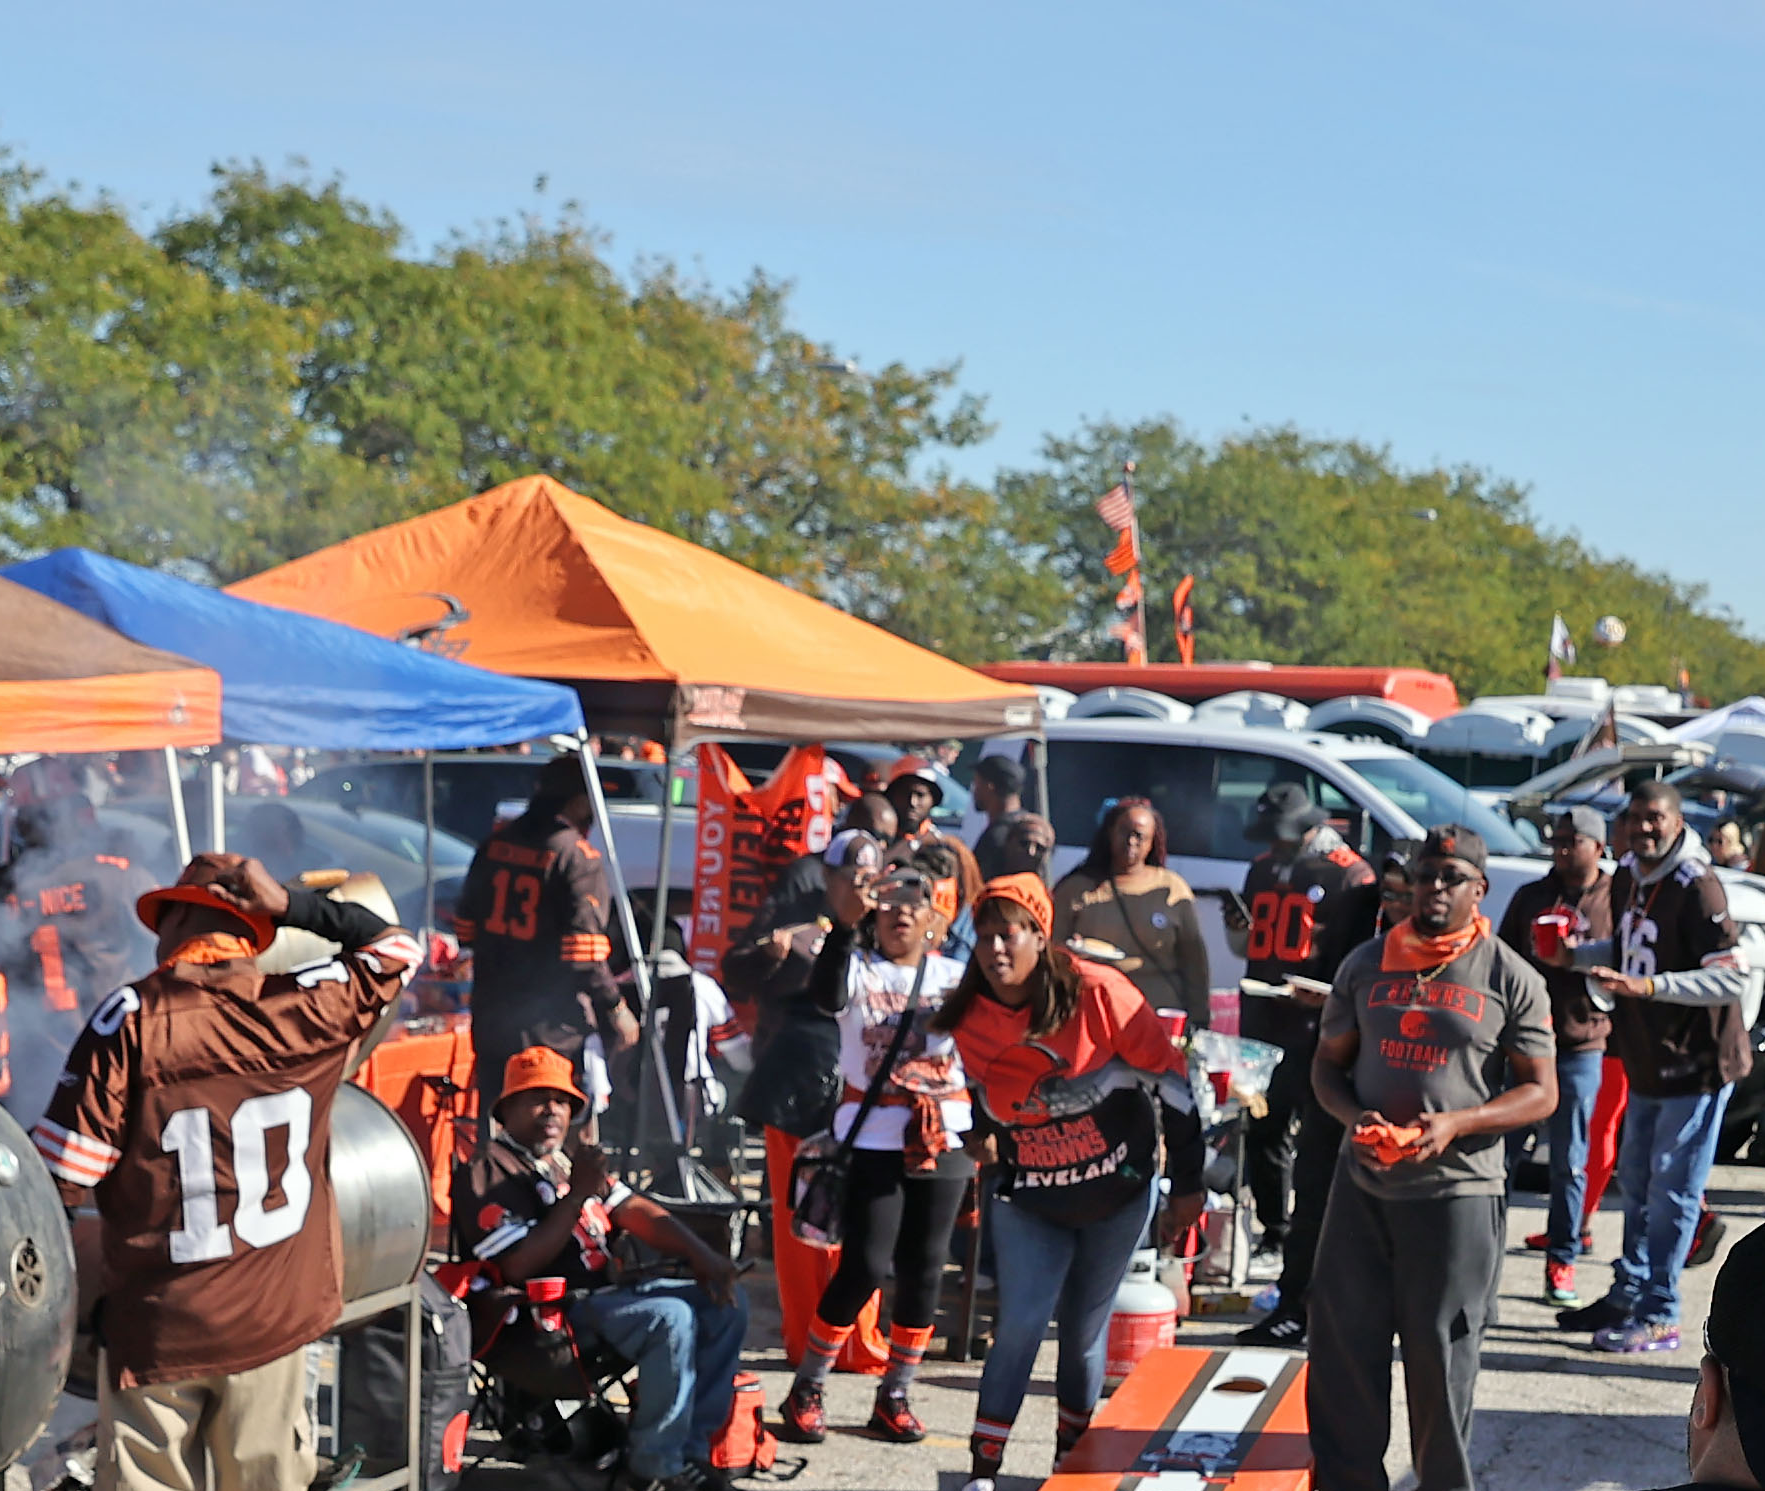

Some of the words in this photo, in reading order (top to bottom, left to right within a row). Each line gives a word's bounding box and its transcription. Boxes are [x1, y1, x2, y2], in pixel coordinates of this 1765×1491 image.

[486, 868, 541, 941] 13
[1247, 891, 1315, 962] 80
[1380, 1038, 1449, 1065] FOOTBALL
[161, 1086, 312, 1264] 10
[1013, 1141, 1128, 1190] LEVELAND
